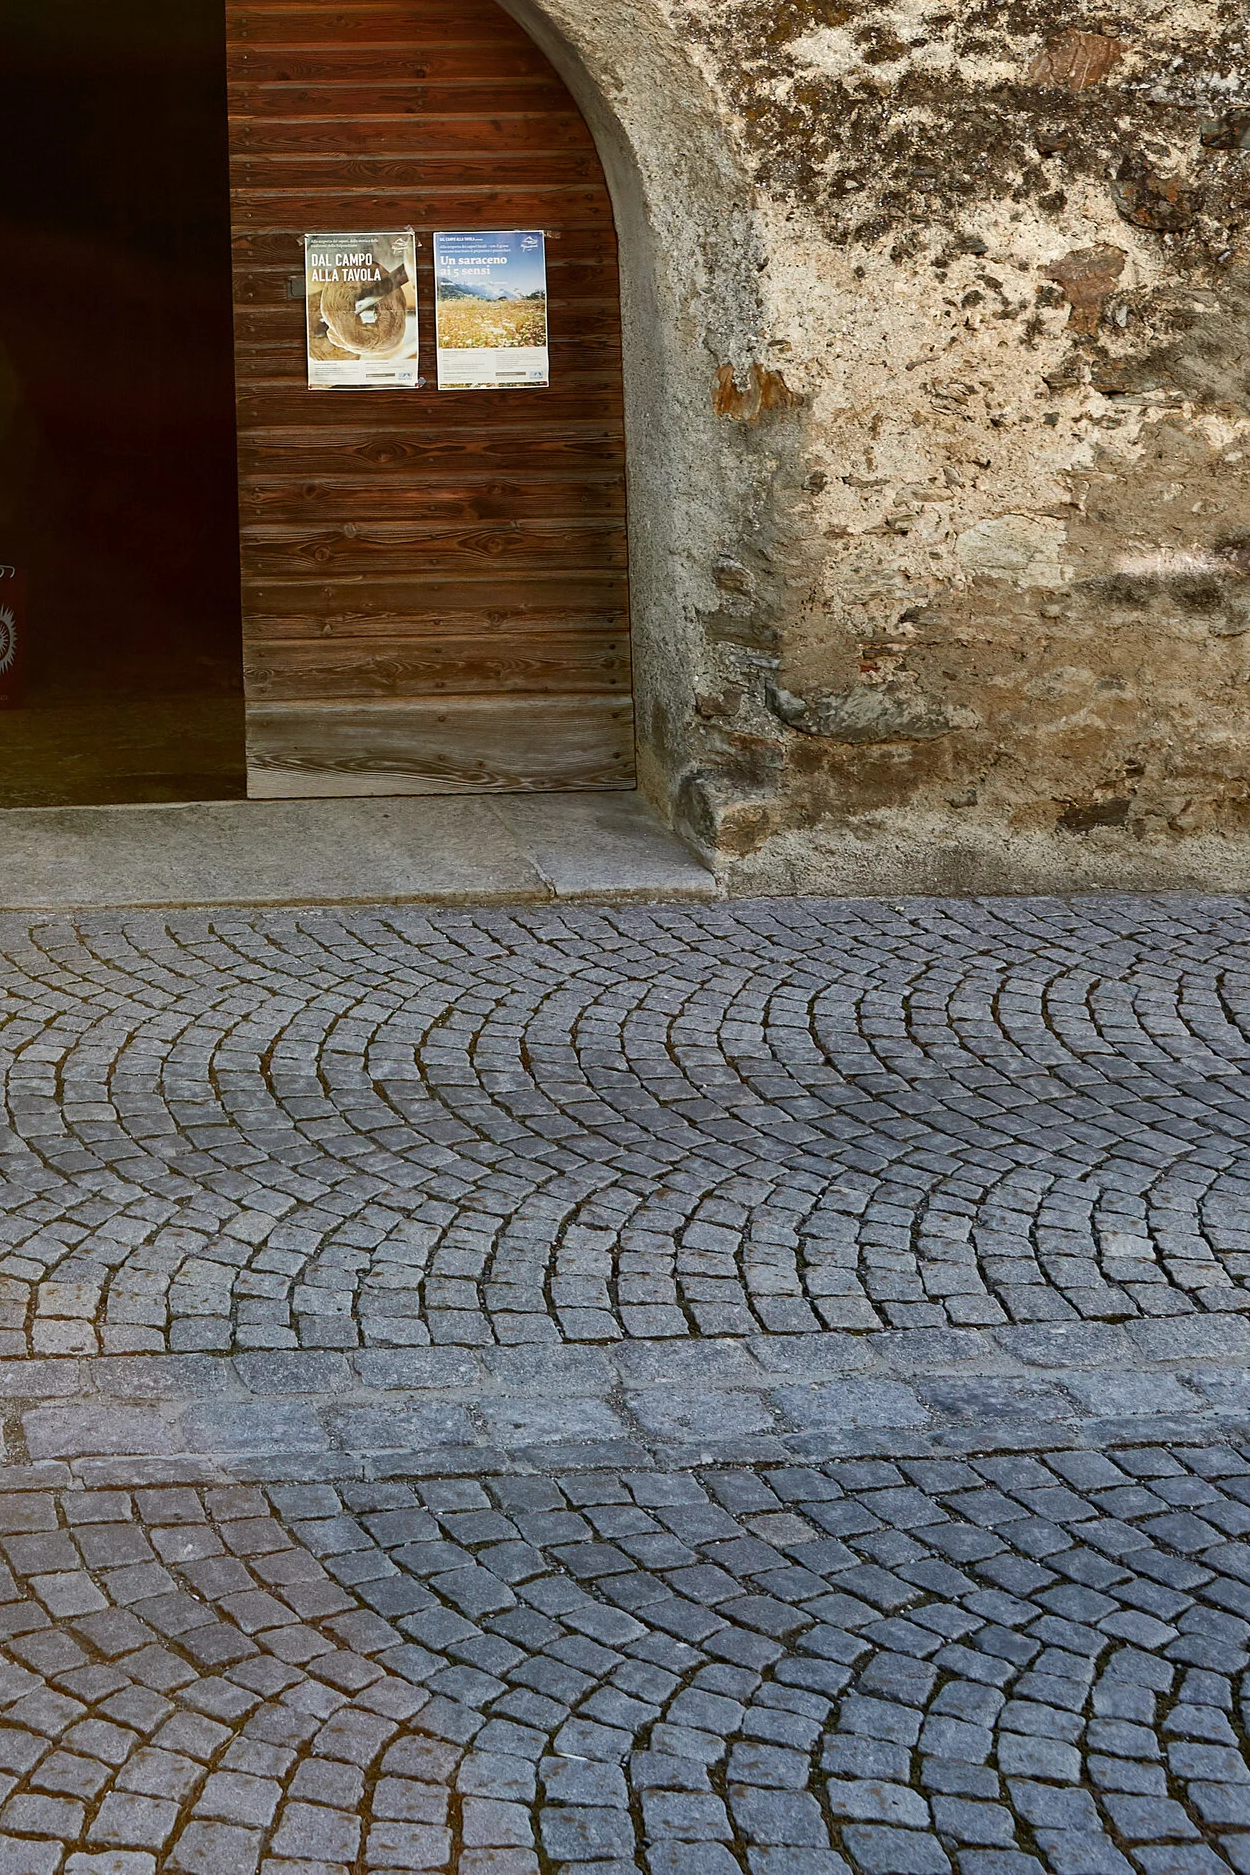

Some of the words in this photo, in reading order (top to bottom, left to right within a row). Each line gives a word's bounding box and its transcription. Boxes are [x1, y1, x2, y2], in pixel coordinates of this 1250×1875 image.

[311, 253, 332, 267] DAL
[336, 253, 372, 267] CAMPO
[440, 256, 455, 264] Un
[458, 256, 507, 264] saraceno
[312, 269, 339, 282] ALLA
[342, 268, 381, 281] TAVOLA
[440, 266, 451, 275] ai
[453, 268, 459, 277] 5
[461, 265, 490, 275] sensi
